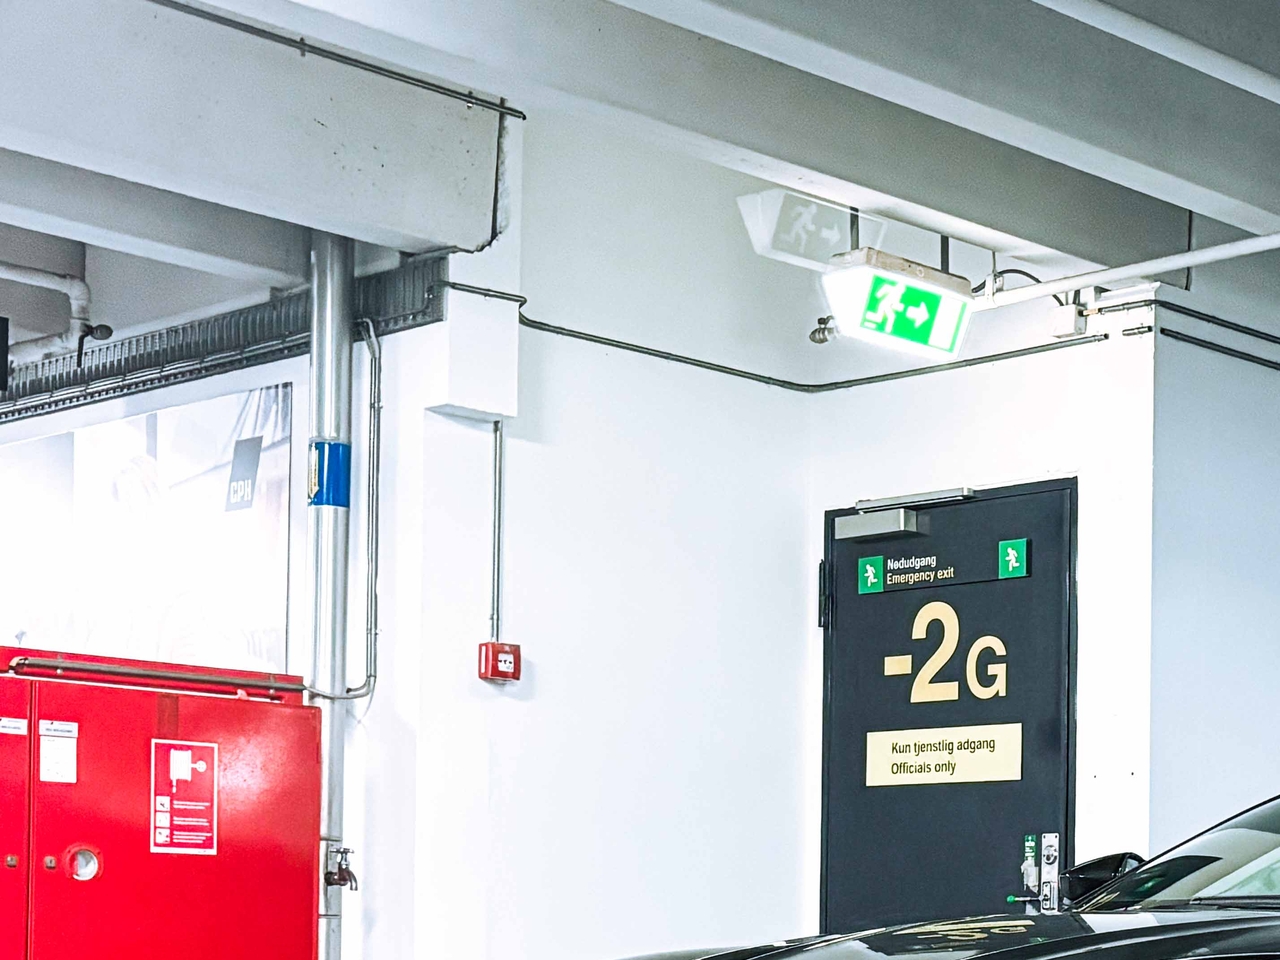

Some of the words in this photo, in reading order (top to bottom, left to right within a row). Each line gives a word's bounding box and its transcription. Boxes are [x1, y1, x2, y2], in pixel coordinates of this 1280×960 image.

[230, 479, 252, 504] CPH
[887, 556, 937, 570] Nødudgang
[886, 571, 935, 585] Emergency
[937, 566, 954, 579] exit
[892, 742, 911, 754] Kun
[914, 739, 954, 757] tjenstlig
[957, 738, 996, 754] adgang
[891, 762, 932, 775] Officials
[934, 760, 957, 776] only
